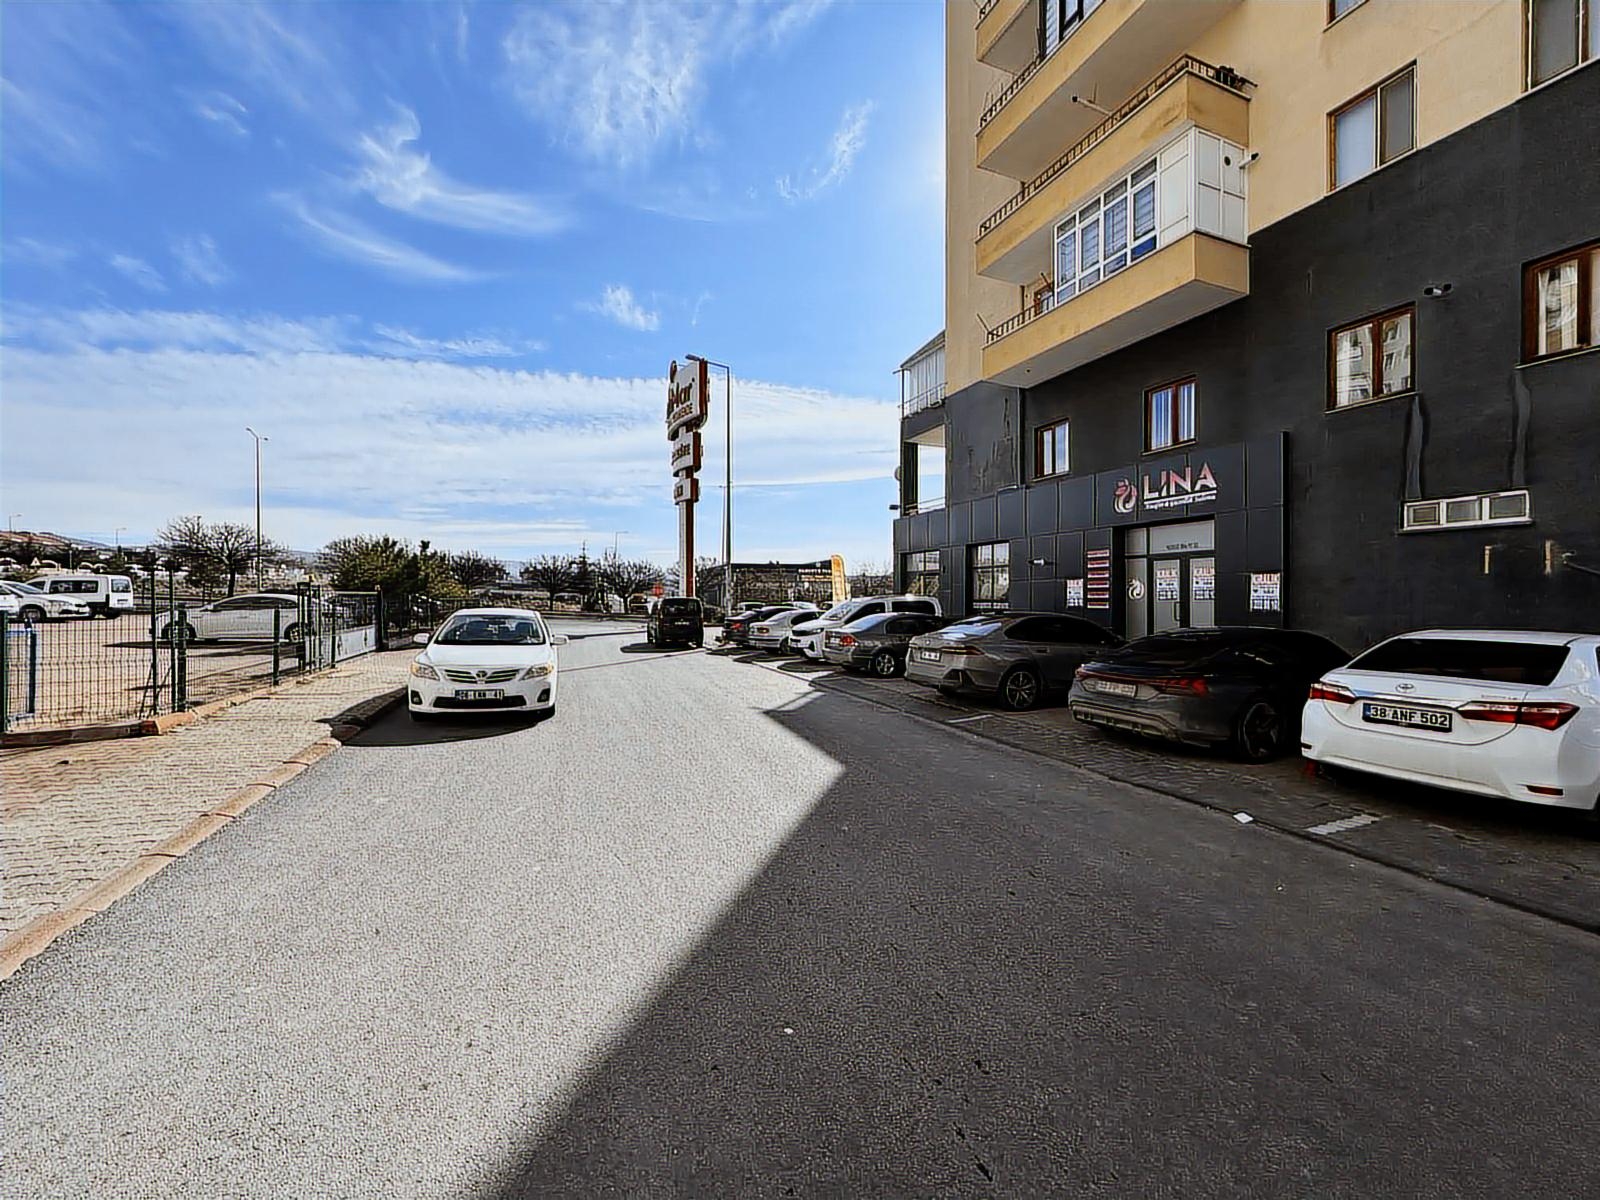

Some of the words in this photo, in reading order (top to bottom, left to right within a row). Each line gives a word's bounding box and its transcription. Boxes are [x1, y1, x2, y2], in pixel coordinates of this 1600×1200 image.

[1144, 462, 1217, 500] LINA
[1371, 706, 1387, 718] 38
[1392, 709, 1417, 722] ANF
[1420, 713, 1448, 727] 502
